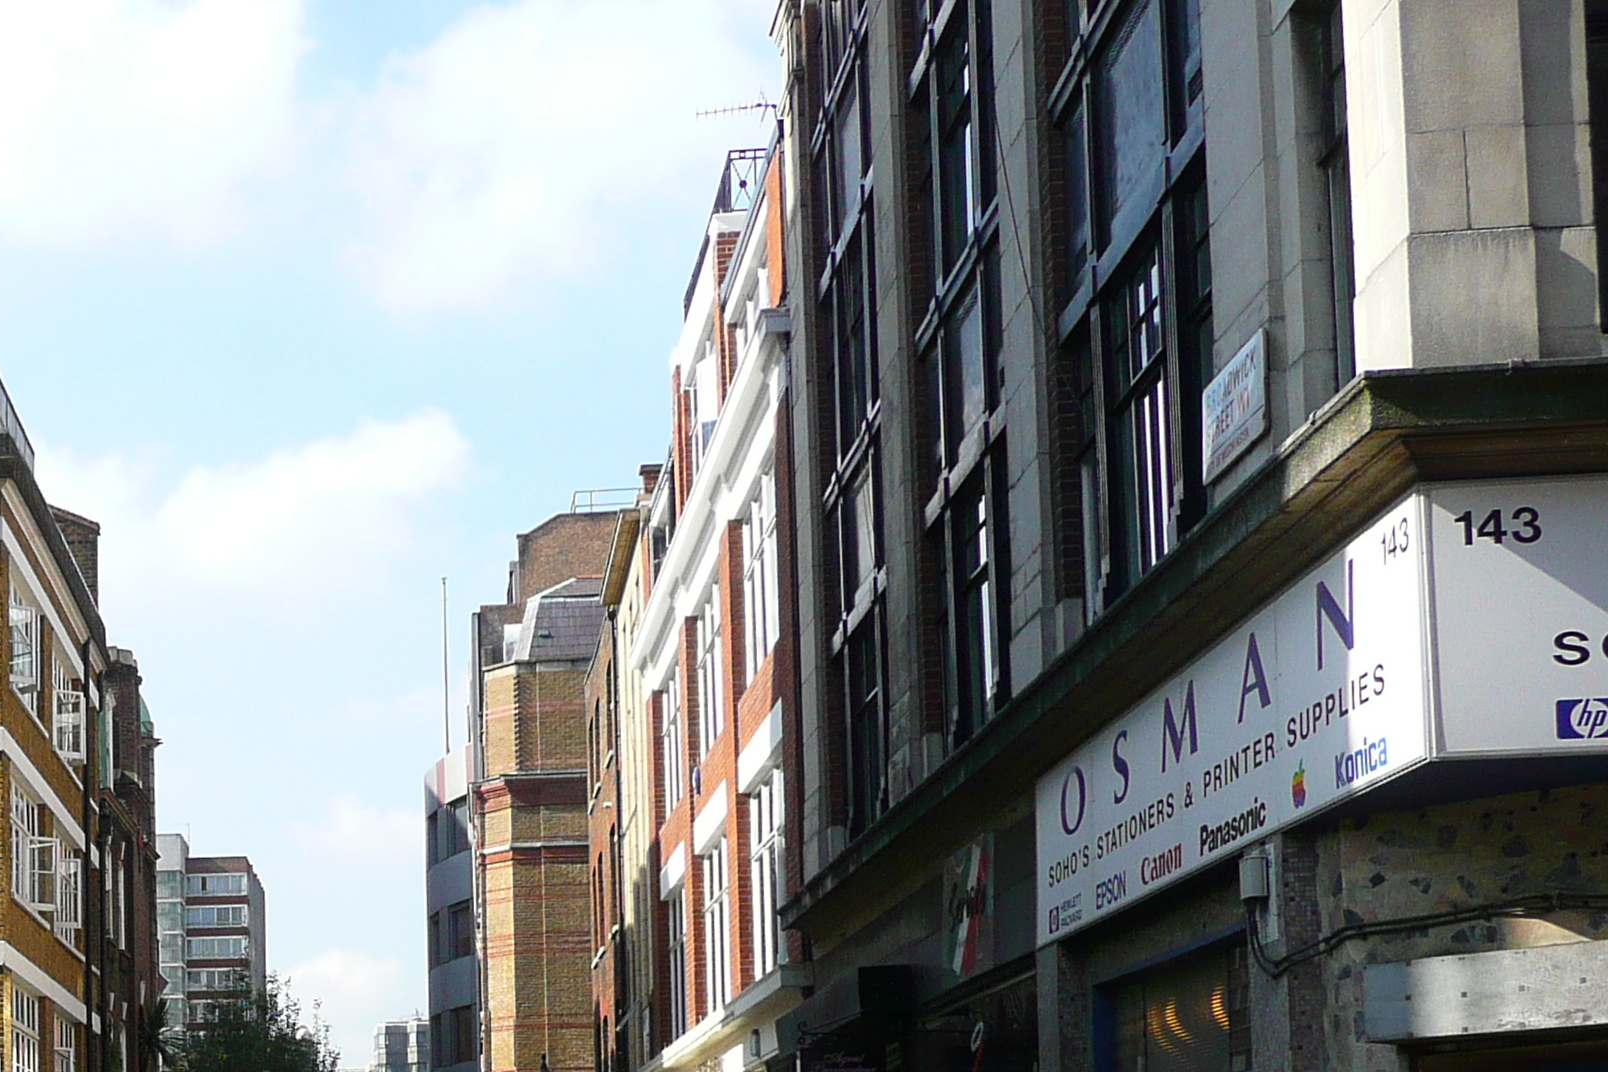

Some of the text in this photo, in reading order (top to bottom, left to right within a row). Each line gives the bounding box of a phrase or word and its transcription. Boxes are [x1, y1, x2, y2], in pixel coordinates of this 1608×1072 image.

[1380, 517, 1409, 565] 143
[1454, 507, 1542, 545] 143
[1060, 558, 1354, 836] OSMAN
[1553, 630, 1608, 666] S
[1048, 663, 1385, 888] SOHO'S STATIONERS & PRINTER SUPPLIES
[1096, 737, 1388, 910] EPSON Canon Panasonic Konica
